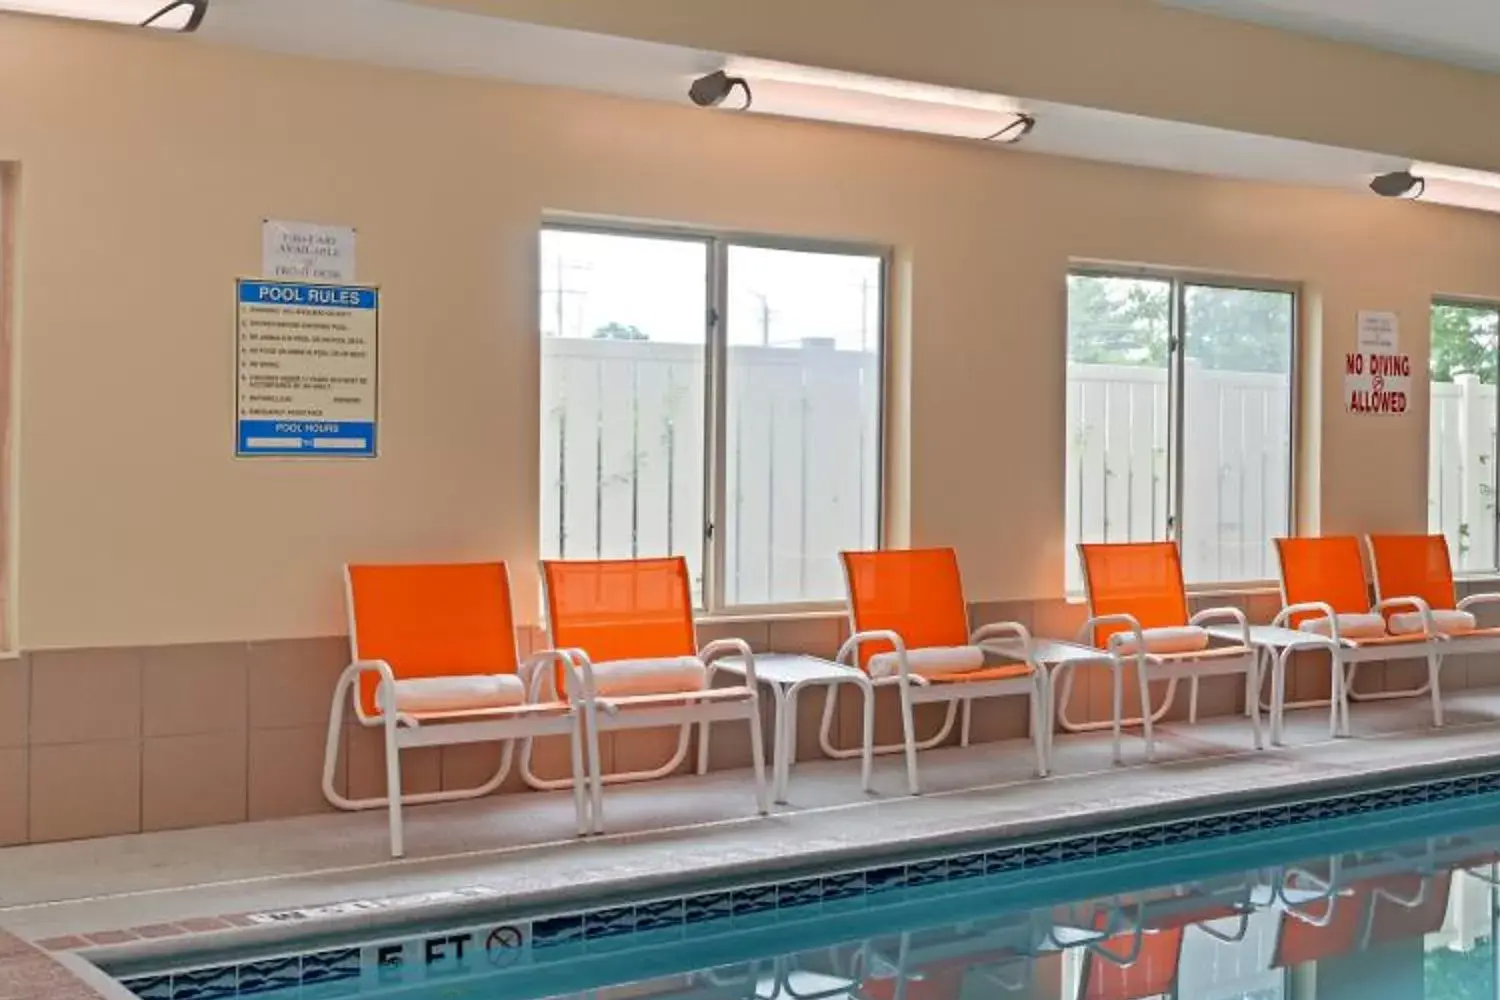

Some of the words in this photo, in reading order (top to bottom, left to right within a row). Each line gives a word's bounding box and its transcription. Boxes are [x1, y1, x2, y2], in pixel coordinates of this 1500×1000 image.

[259, 285, 304, 301] POOL
[308, 288, 361, 305] RULES
[1346, 353, 1364, 376] NO
[1369, 353, 1410, 377] DIVING
[1350, 390, 1407, 413] ALLOWED
[275, 422, 303, 433] POOL
[305, 423, 340, 433] HOURS
[426, 933, 472, 965] FT
